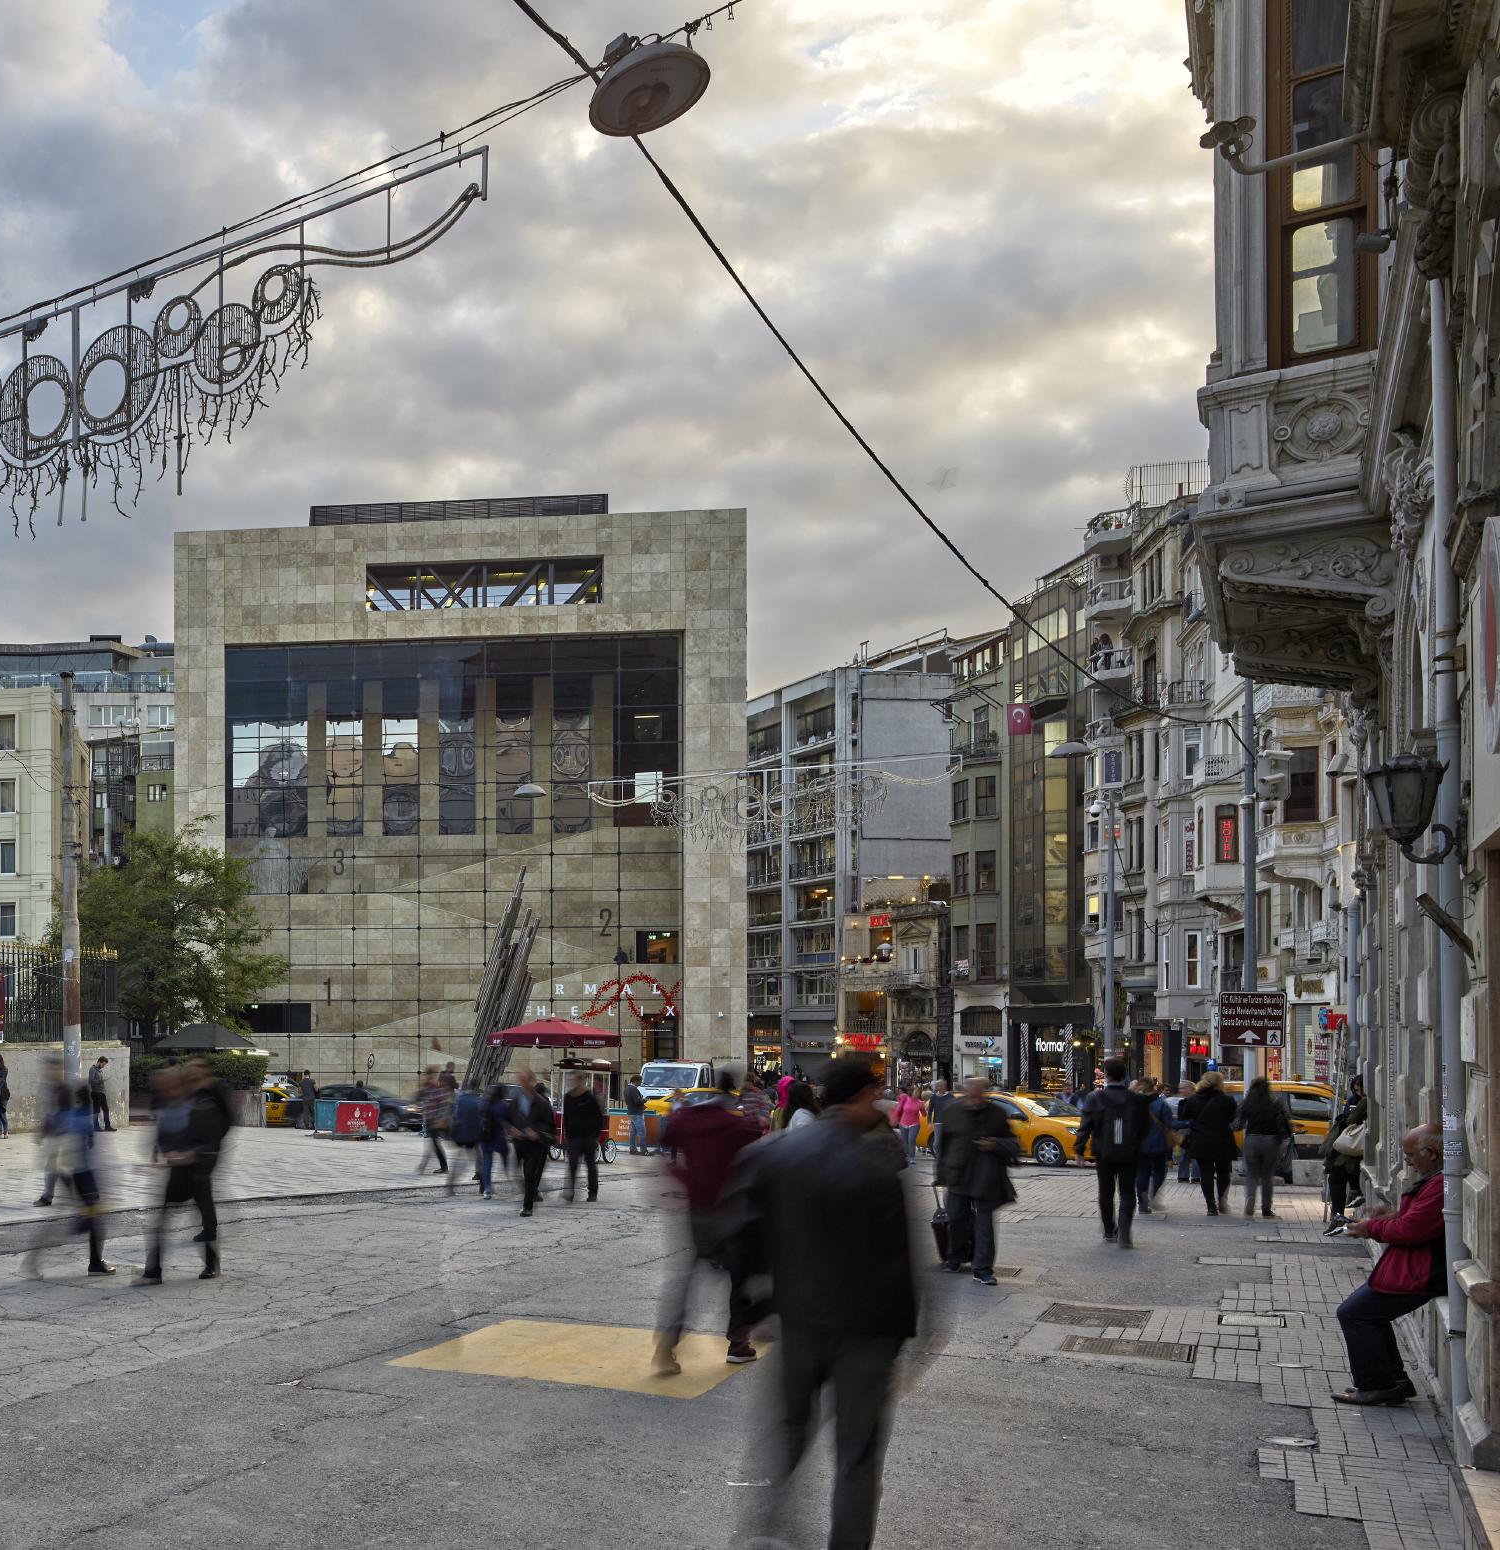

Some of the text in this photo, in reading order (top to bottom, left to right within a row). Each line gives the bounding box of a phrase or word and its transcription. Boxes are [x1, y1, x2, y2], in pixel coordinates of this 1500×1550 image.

[1222, 820, 1232, 859] HOTEL
[332, 848, 345, 876] 3
[599, 908, 612, 937] 2
[323, 977, 332, 1006] 1
[536, 1005, 676, 1017] HELIX
[1035, 1037, 1067, 1053] flormar
